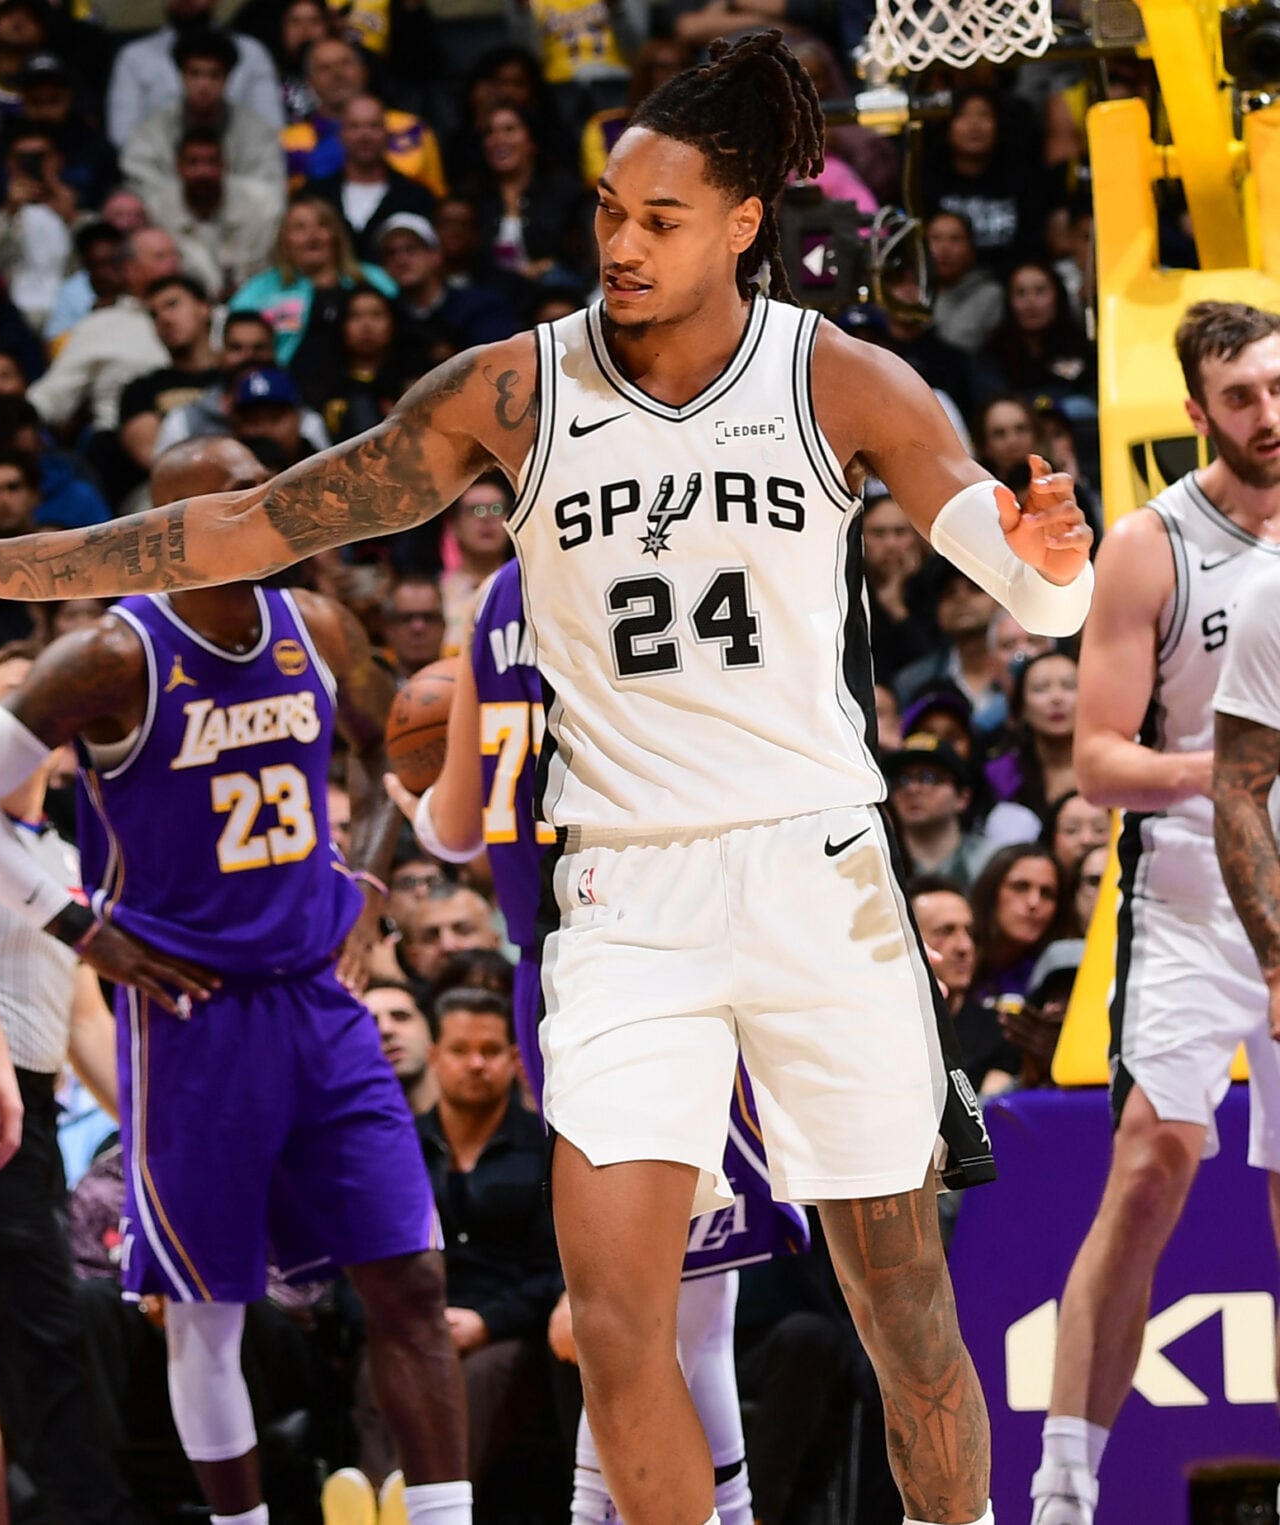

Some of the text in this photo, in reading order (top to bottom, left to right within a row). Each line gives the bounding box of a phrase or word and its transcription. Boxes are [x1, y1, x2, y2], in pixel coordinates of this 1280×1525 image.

[724, 424, 776, 438] LEDGER
[555, 472, 805, 560] SPURS
[604, 566, 765, 681] 24
[170, 691, 320, 771] LAKERS
[210, 763, 318, 873] 23
[871, 1198, 900, 1221] 24
